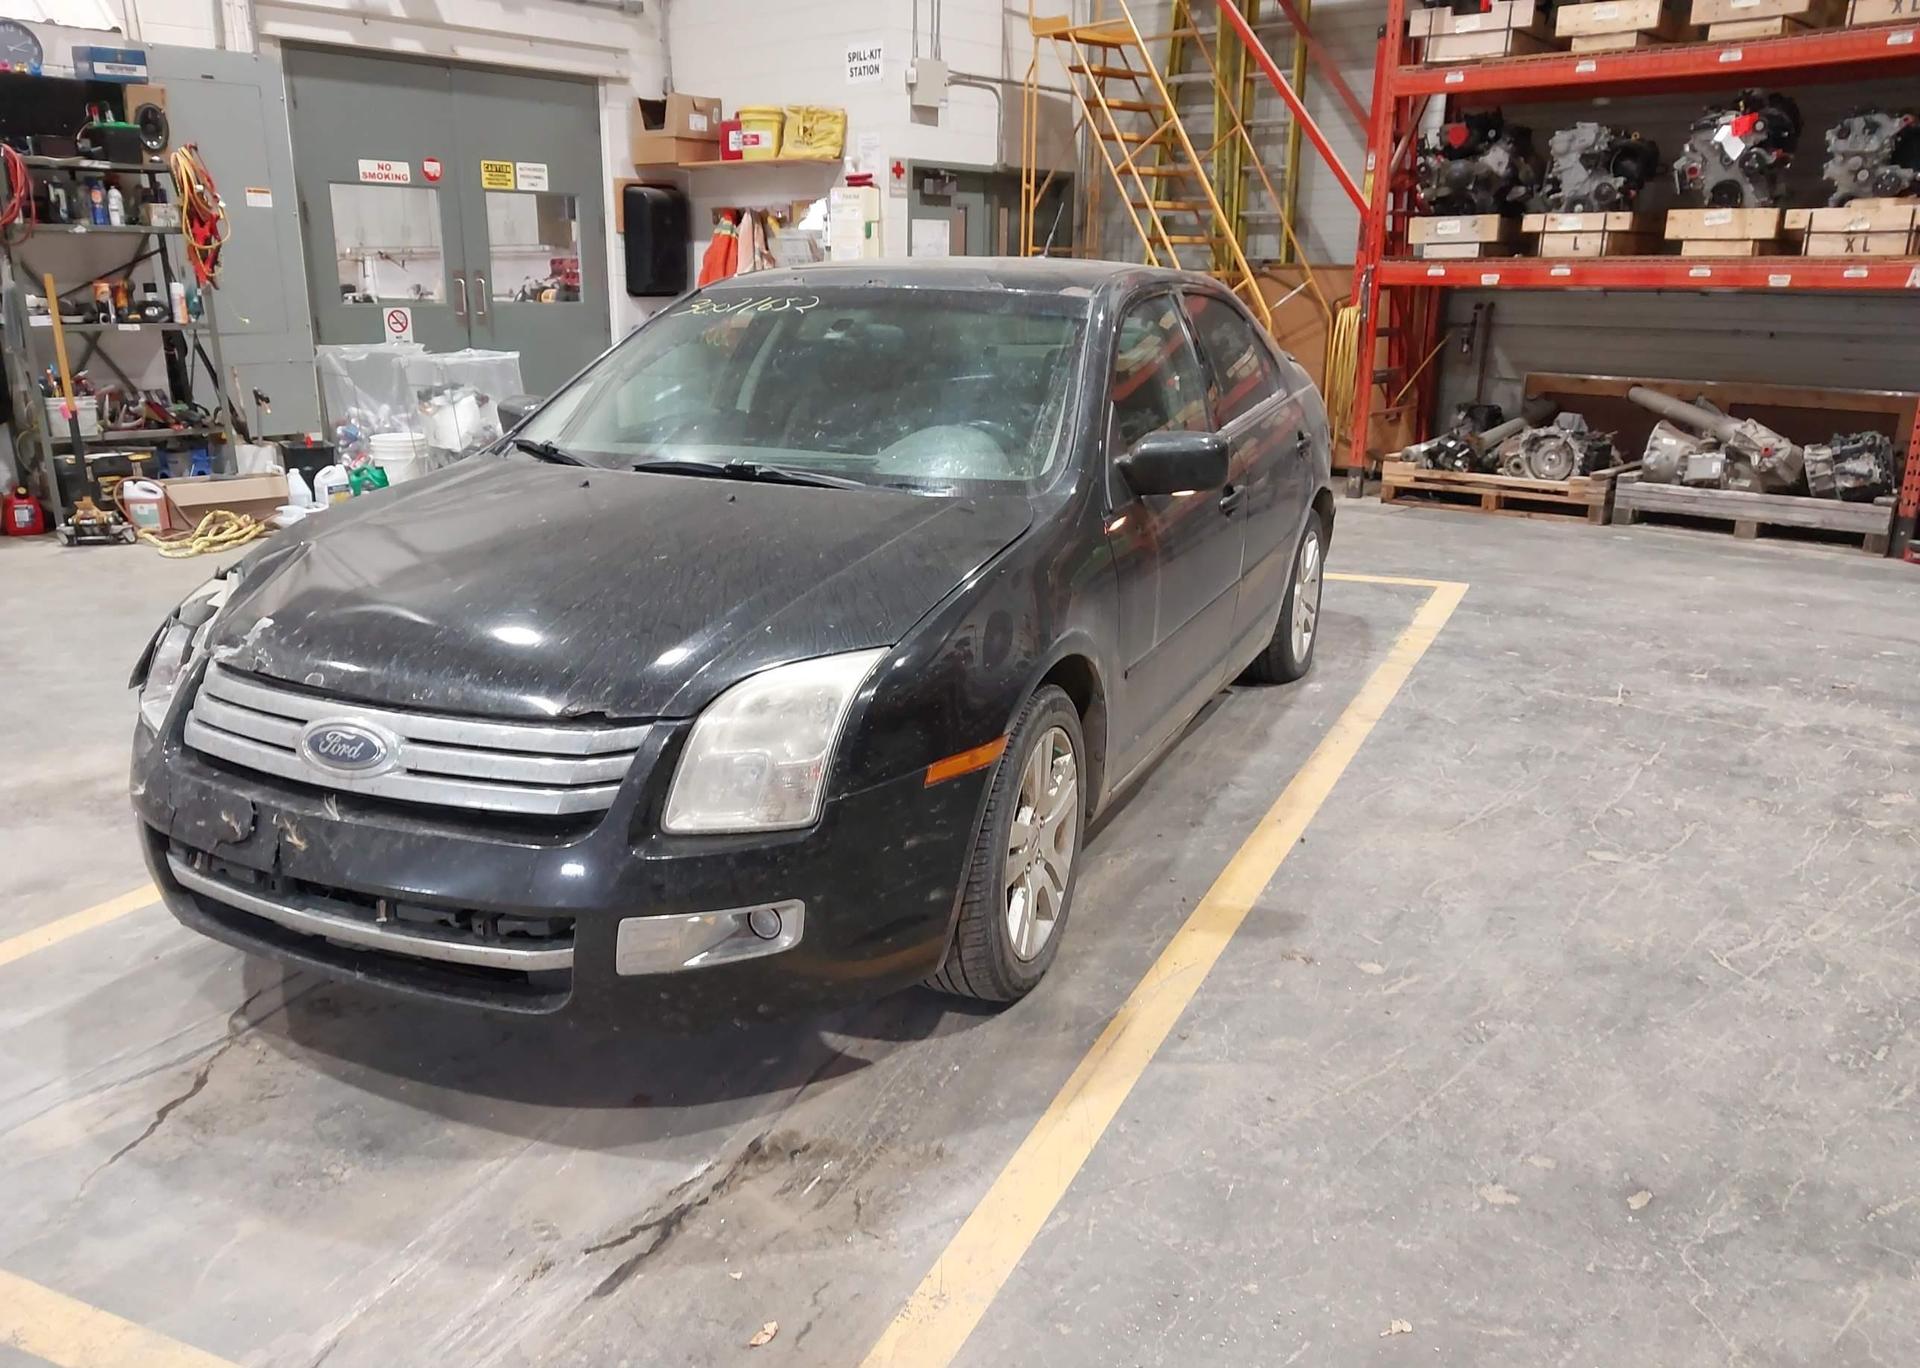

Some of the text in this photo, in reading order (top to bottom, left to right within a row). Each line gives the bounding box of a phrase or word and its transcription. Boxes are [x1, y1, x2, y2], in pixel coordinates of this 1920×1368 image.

[848, 48, 881, 63] SPILL-KIT
[850, 64, 880, 77] STATION
[377, 162, 391, 171] NO
[483, 163, 511, 173] CAUTION
[361, 171, 408, 181] SMOKING
[319, 731, 365, 758] Ford
